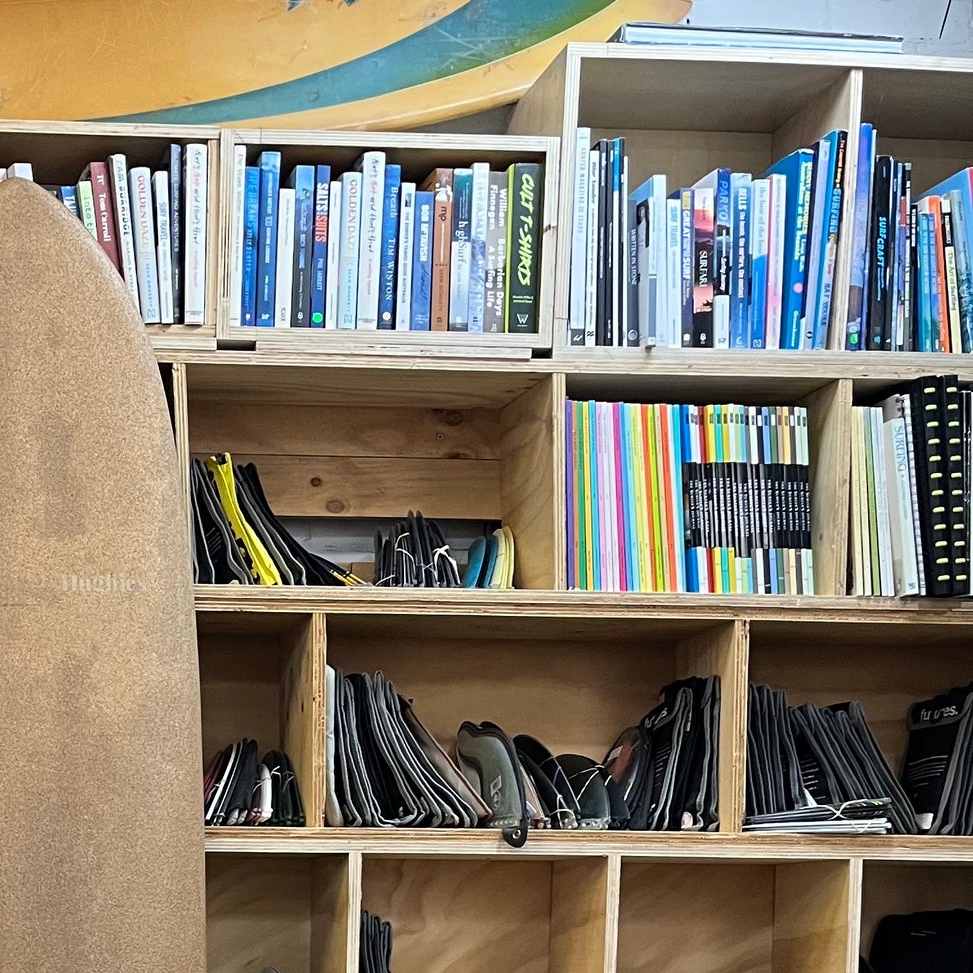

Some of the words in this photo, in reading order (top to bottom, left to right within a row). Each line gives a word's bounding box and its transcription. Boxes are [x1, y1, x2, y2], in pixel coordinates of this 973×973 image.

[83, 196, 91, 219] into
[98, 193, 107, 211] Tom
[137, 176, 146, 218] GOLDEN
[247, 192, 257, 227] DREAMS
[316, 183, 329, 211] SALTS
[348, 180, 357, 223] GOLDEN
[389, 187, 398, 218] Breath
[488, 185, 497, 230] Finnegan
[498, 188, 507, 227] William
[521, 174, 534, 213] CULT
[718, 180, 728, 220] PARKO
[738, 188, 747, 210] BELLS
[101, 212, 111, 241] Carroll
[421, 205, 429, 222] BOB
[439, 206, 447, 221] mp
[829, 188, 842, 233] SURFING
[139, 221, 148, 247] DAZE
[315, 216, 326, 242] SUITS
[347, 226, 356, 254] DAZE
[388, 238, 396, 255] TIM
[518, 216, 533, 285] T-SHIRTS
[486, 255, 495, 288] Surfing
[496, 239, 505, 289] Barbarian
[699, 250, 707, 286] SURFARI
[385, 261, 394, 301] WINTON
[495, 291, 503, 316] Days
[949, 286, 957, 311] Surfing
[894, 426, 906, 471] SURFING
